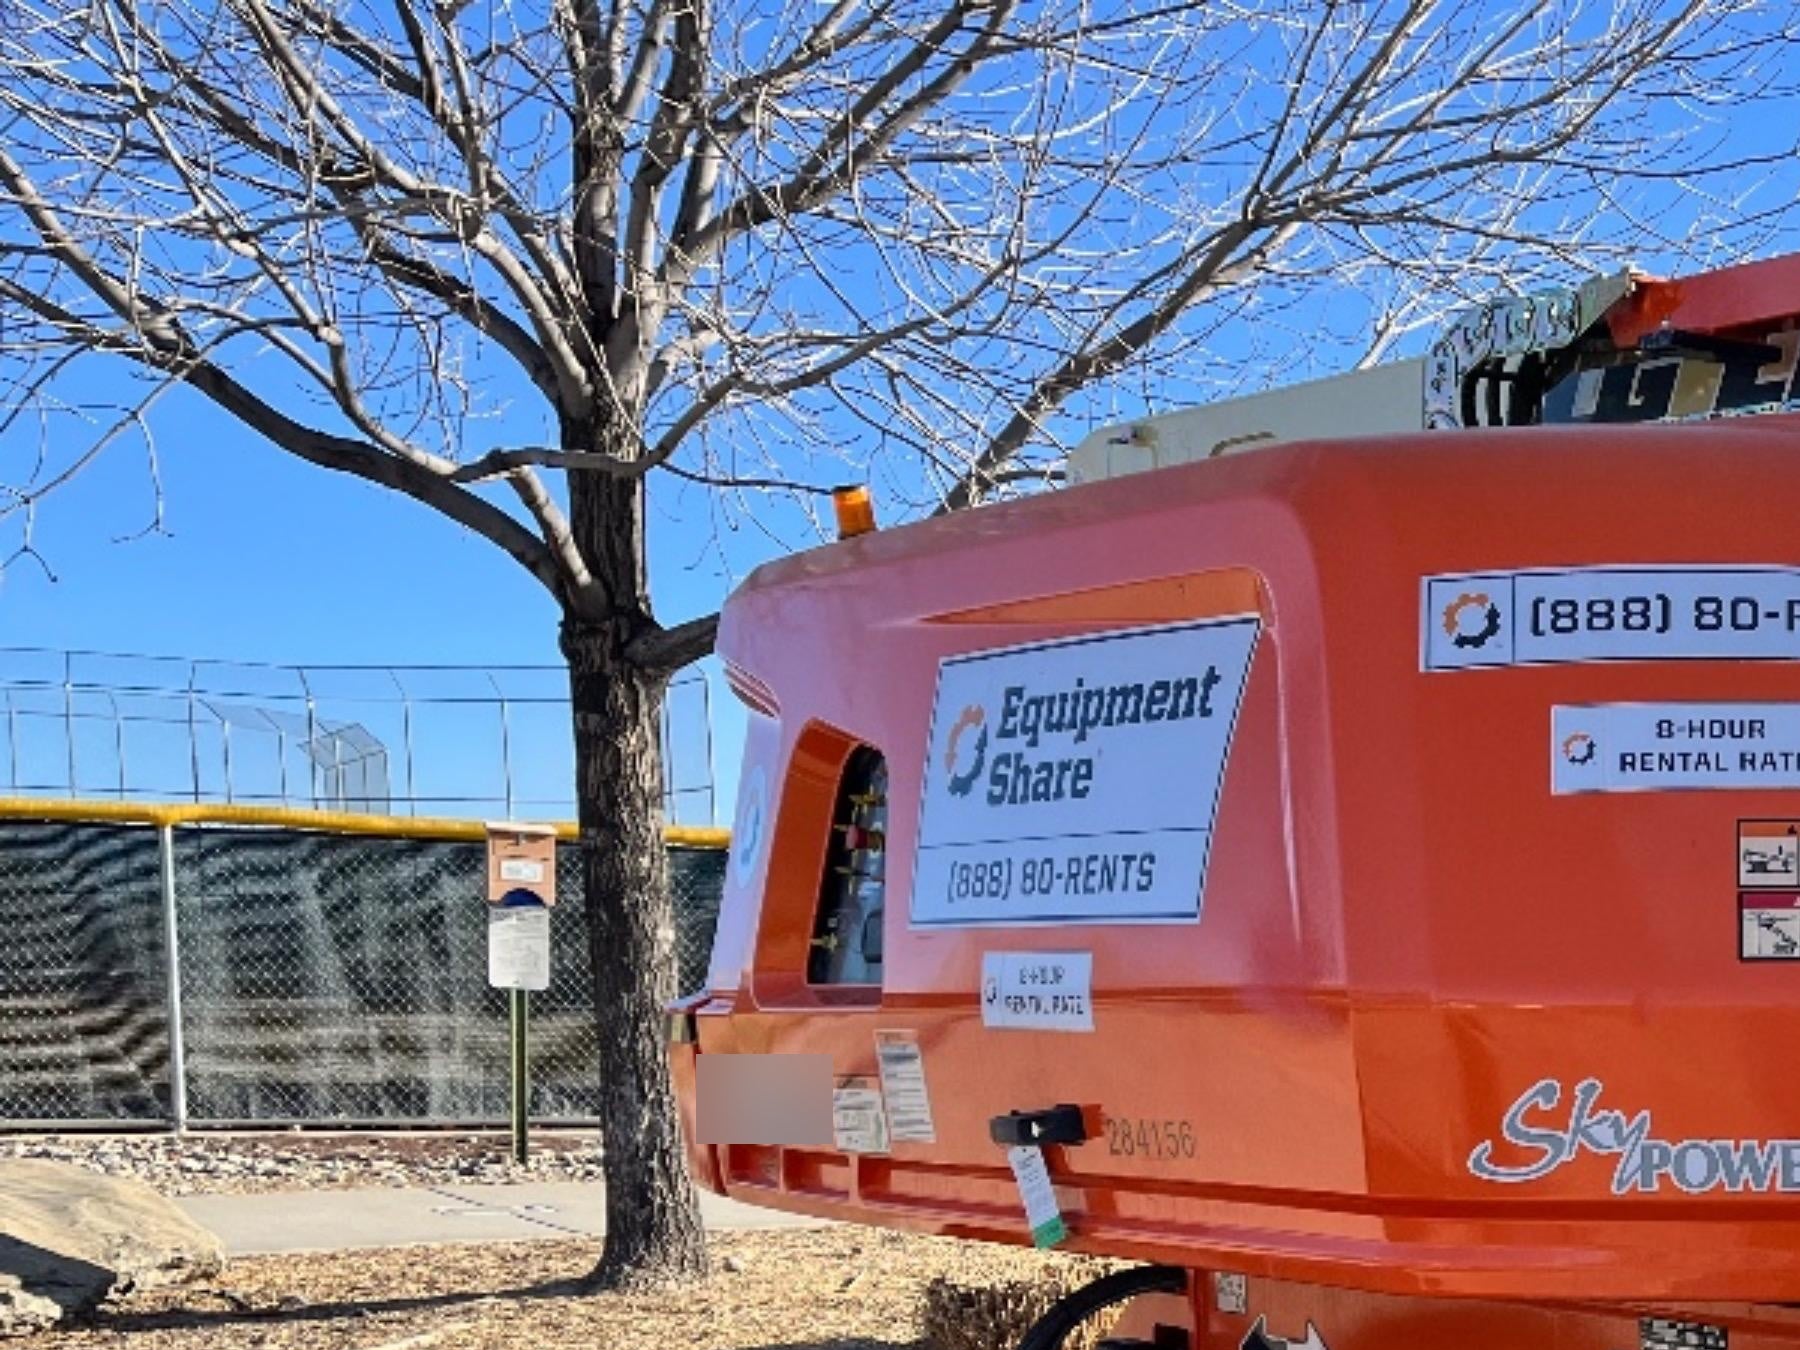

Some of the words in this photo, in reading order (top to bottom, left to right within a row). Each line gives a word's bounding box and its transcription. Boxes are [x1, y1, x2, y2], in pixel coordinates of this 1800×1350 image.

[1530, 596, 1672, 636] (888)
[995, 665, 1222, 747] Equipment
[1656, 720, 1766, 740] 8-HOUR
[986, 752, 1095, 807] Share
[1619, 752, 1728, 773] RENTAL
[946, 858, 1013, 903] (888)
[1020, 852, 1157, 897] 80-RENTS
[1105, 1117, 1197, 1159] 284156
